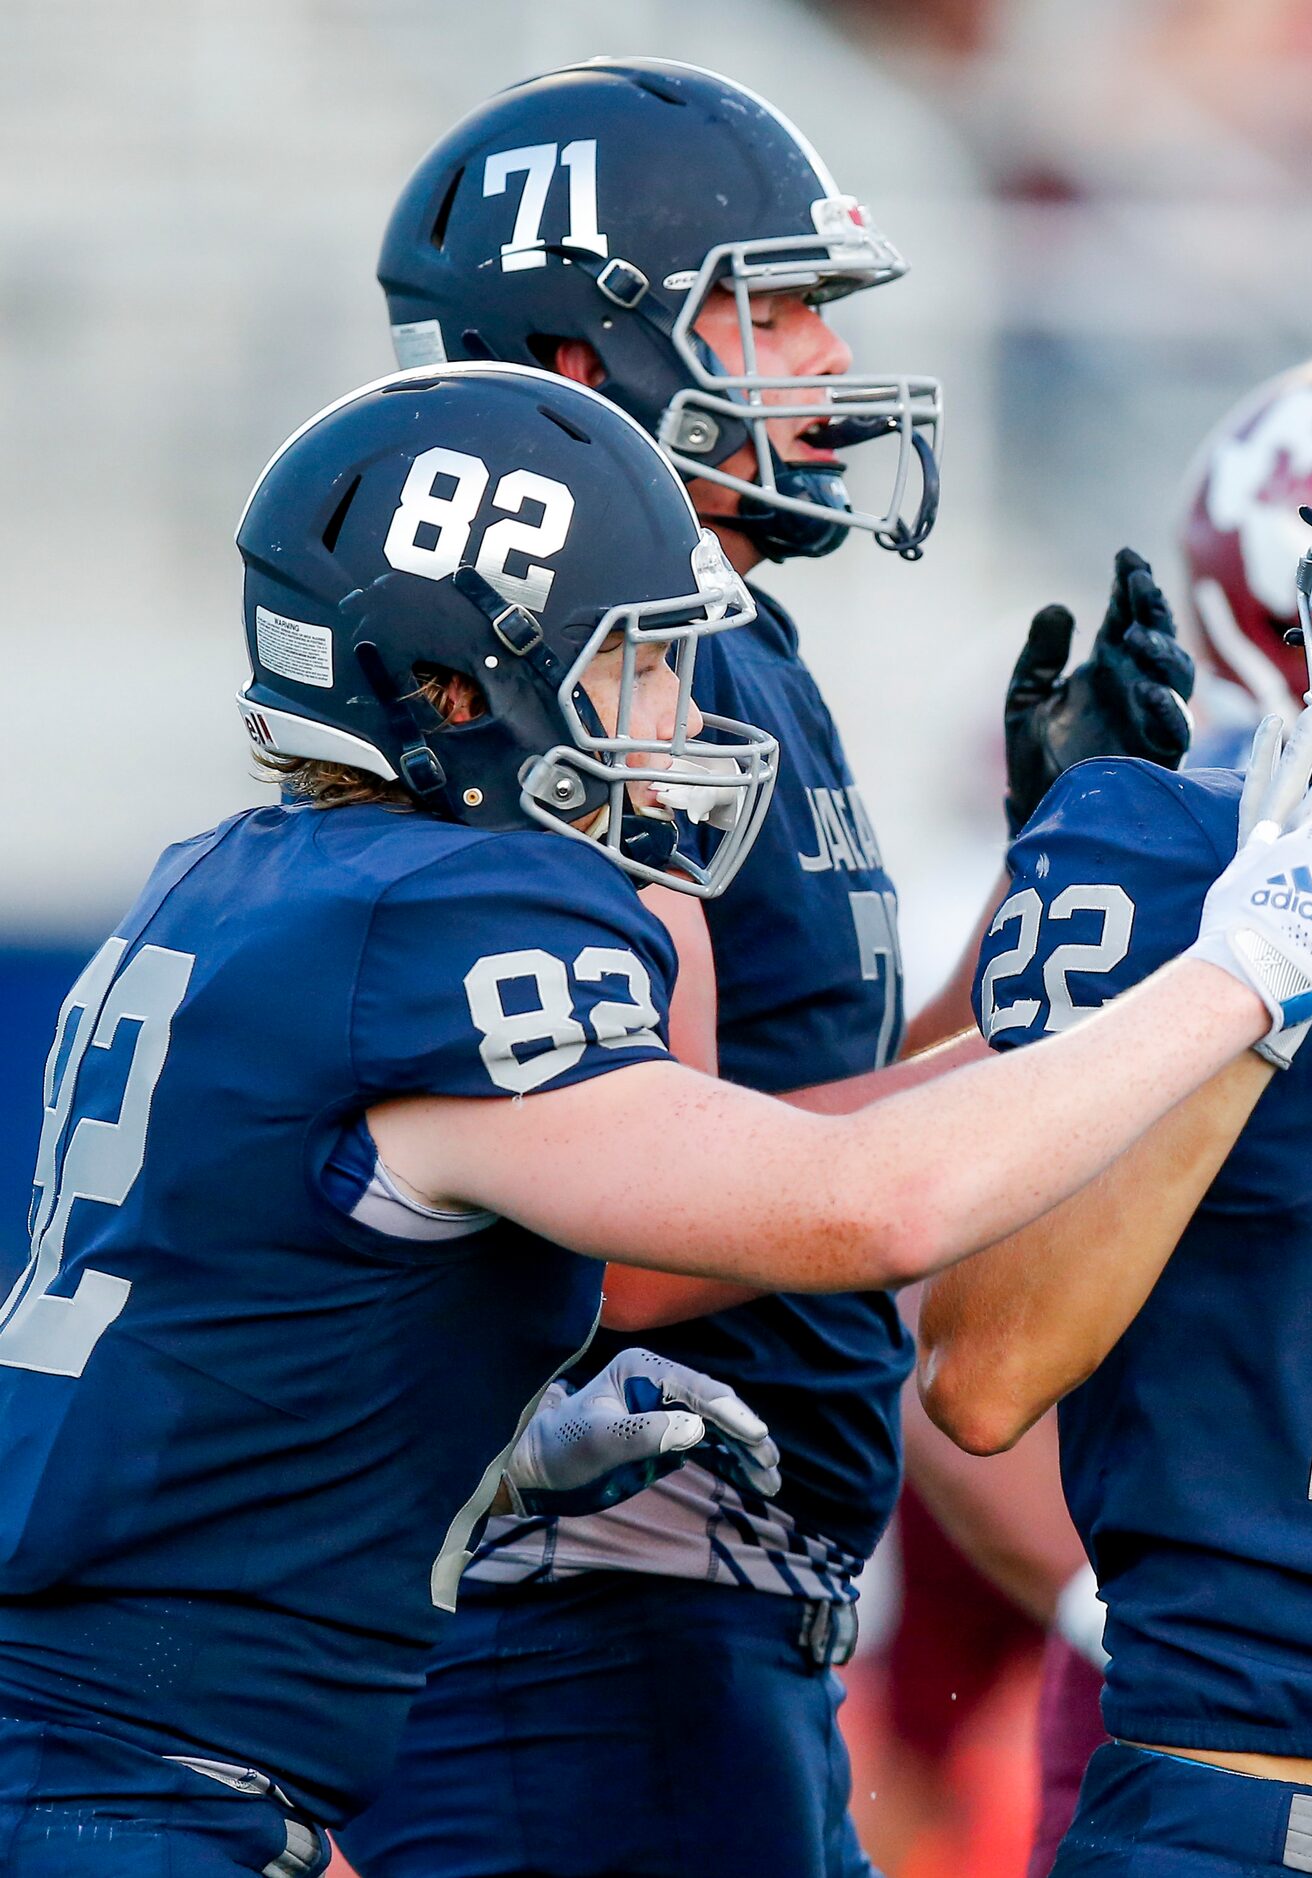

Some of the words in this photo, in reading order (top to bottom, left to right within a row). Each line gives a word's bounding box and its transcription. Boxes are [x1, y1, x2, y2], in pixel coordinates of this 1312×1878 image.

[483, 138, 607, 272] 71
[383, 446, 575, 613] 82
[463, 947, 669, 1092] 82
[981, 884, 1135, 1034] 22
